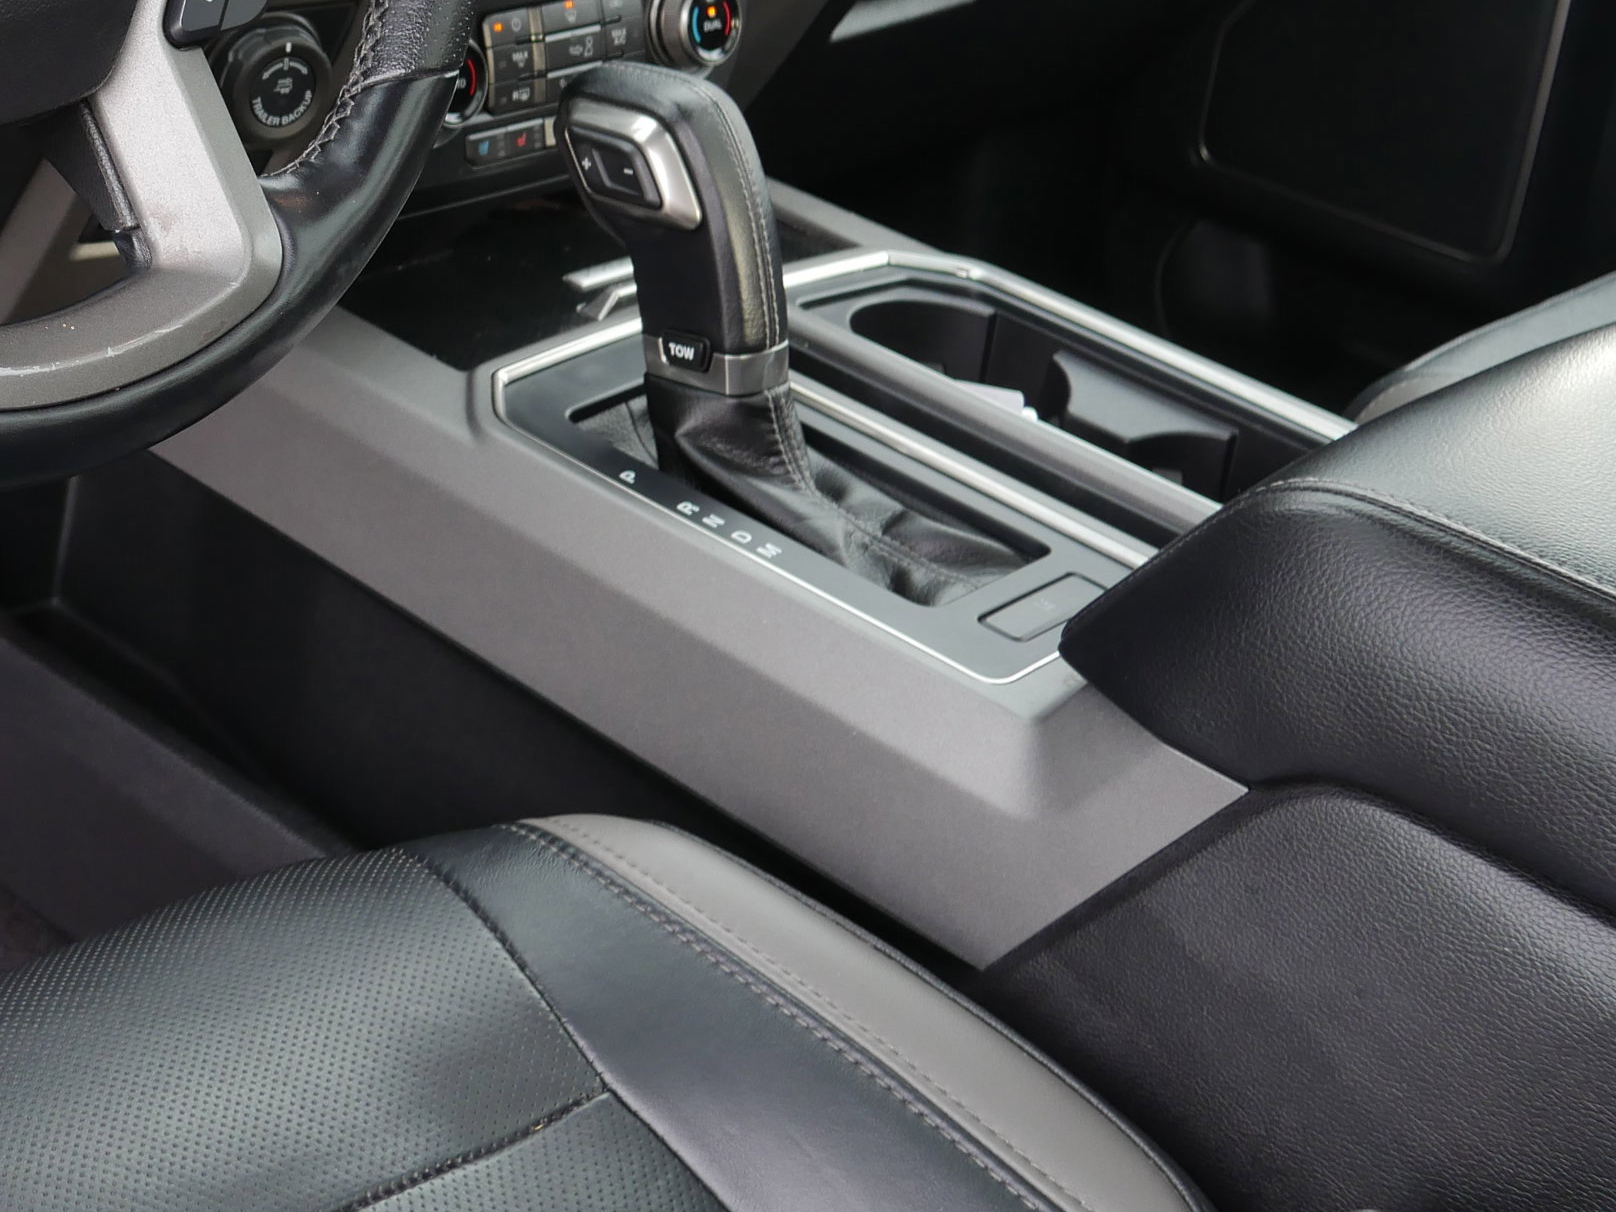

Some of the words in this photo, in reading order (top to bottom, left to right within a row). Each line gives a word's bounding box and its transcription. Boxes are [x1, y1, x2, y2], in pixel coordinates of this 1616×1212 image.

[668, 342, 694, 361] TOW
[619, 470, 636, 484] P
[676, 501, 700, 516] R
[702, 513, 725, 528] N
[730, 530, 752, 544] D
[756, 542, 782, 559] M
